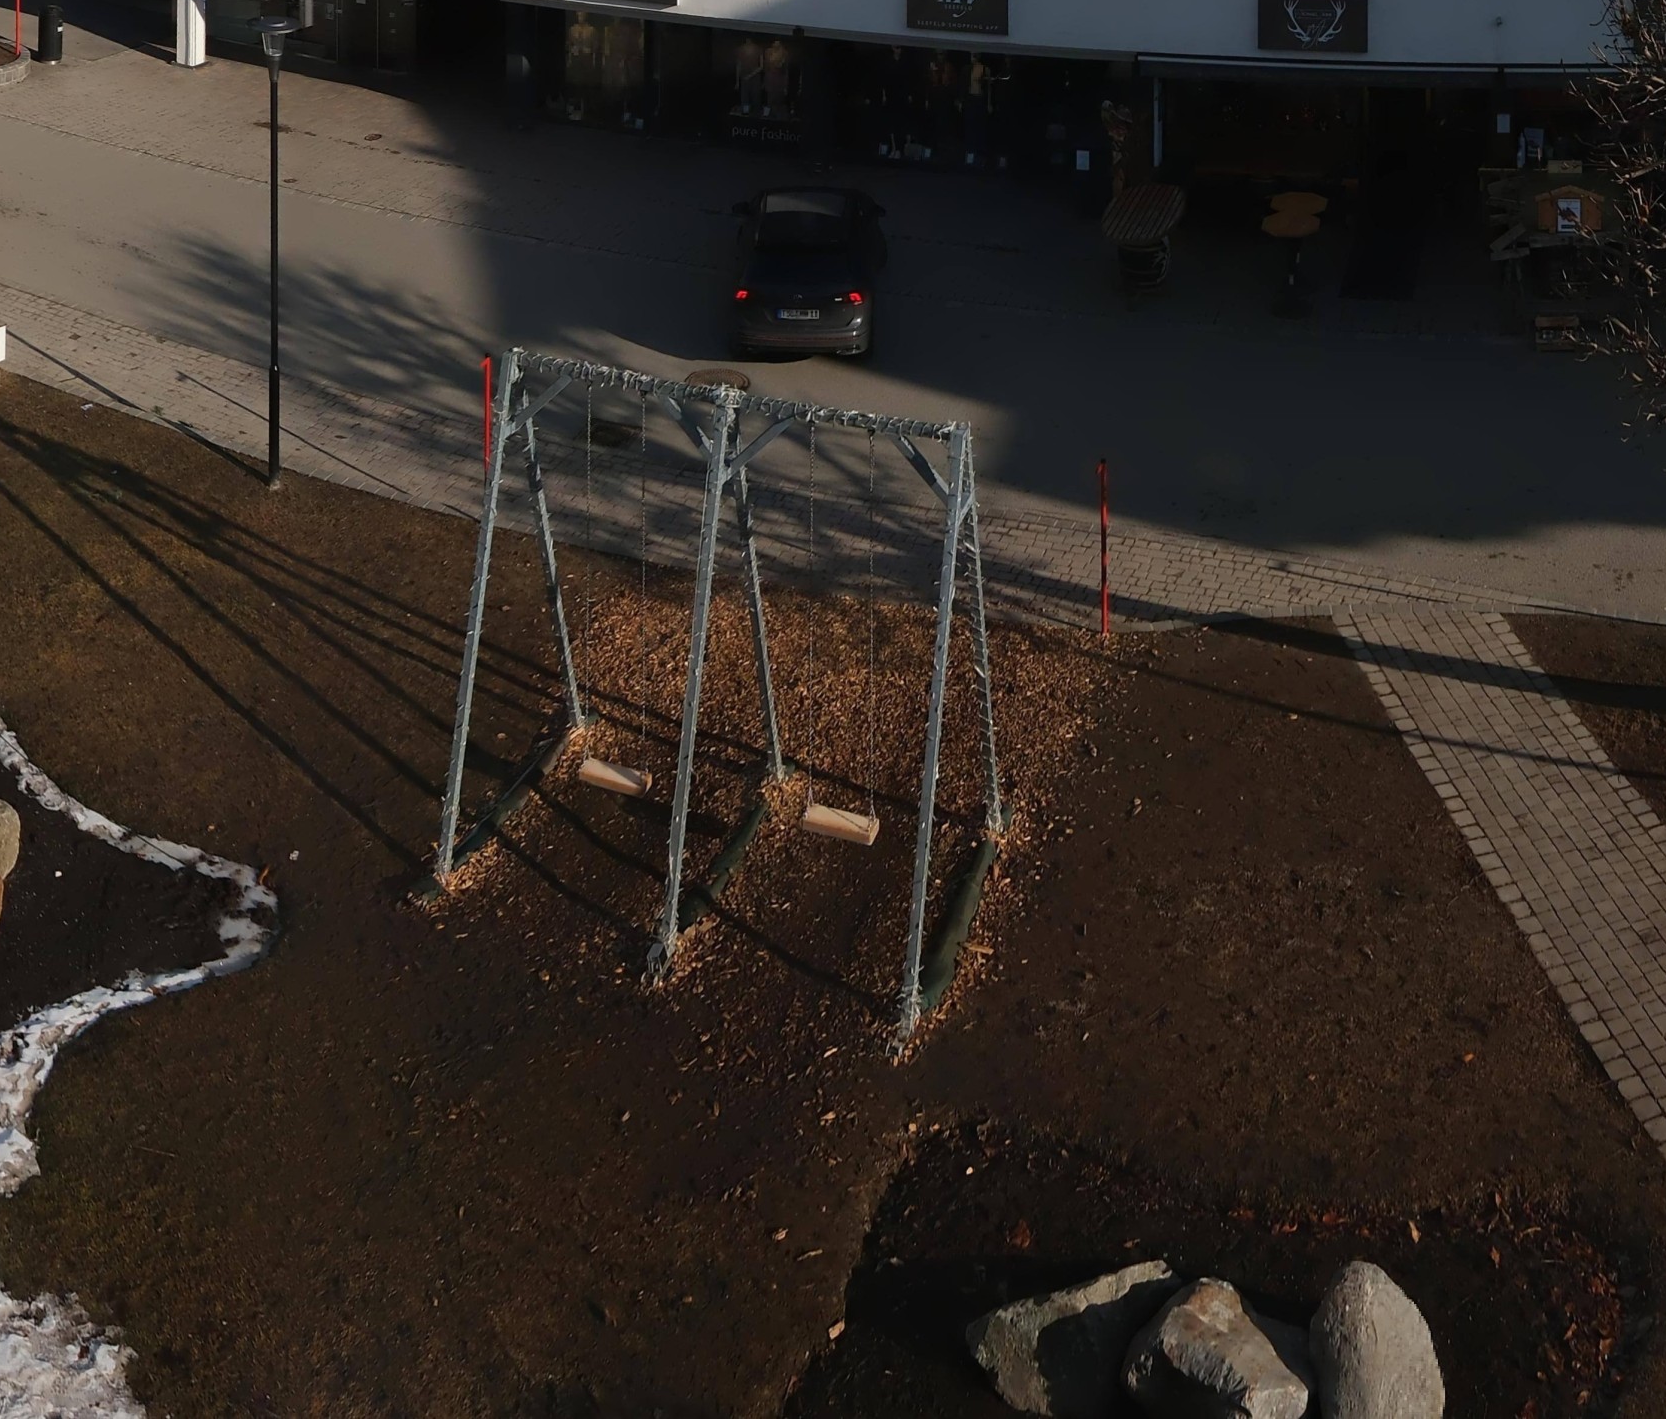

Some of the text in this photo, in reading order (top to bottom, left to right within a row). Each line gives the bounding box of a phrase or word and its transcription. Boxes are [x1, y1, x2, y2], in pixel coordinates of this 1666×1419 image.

[917, 20, 946, 28] SEEFELD
[948, 22, 983, 30] SHOPPING
[732, 126, 758, 137] pure
